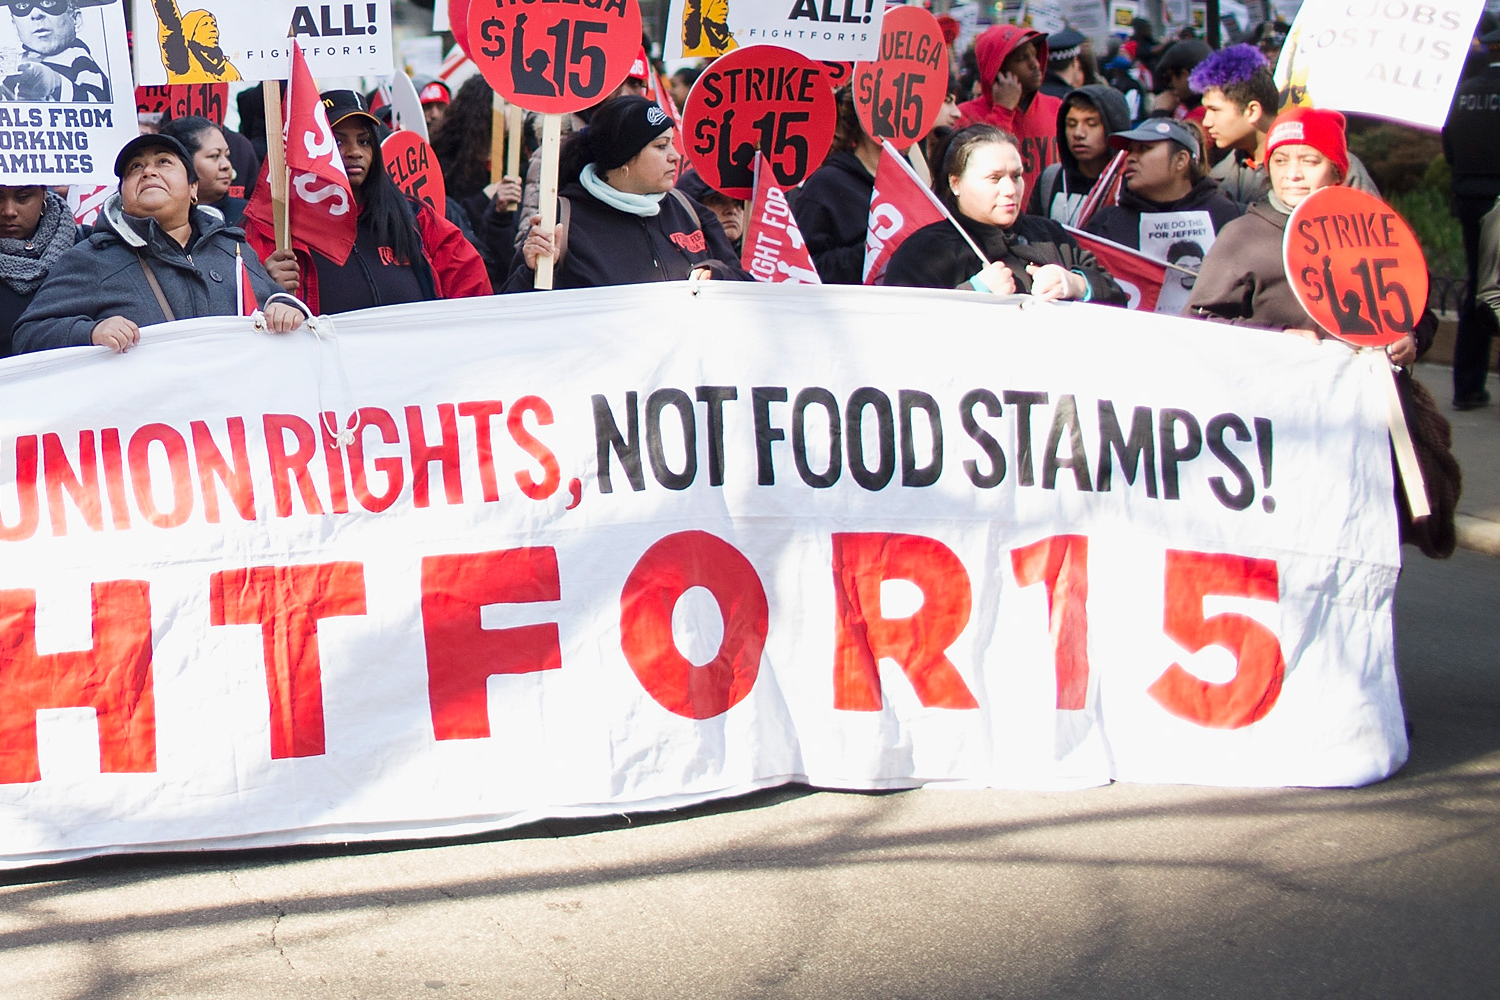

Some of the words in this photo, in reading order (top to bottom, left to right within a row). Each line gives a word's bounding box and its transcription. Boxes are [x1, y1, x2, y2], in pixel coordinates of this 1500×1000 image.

[287, 3, 378, 39] ALL!
[480, 16, 607, 98] $15
[1398, 34, 1452, 61] US
[703, 67, 819, 108] STRIKE
[1366, 62, 1444, 93] ALL!
[50, 108, 114, 128] FROM
[860, 71, 926, 139] $15
[1459, 93, 1500, 111] POLIC
[695, 110, 809, 186] $15
[1148, 231, 1168, 239] FOR
[1171, 228, 1206, 238] JEFFREY
[1154, 222, 1170, 230] WE
[1172, 220, 1186, 229] DO
[1188, 219, 1203, 228] THIS
[1299, 213, 1399, 254] STRIKE
[1301, 256, 1414, 333] $15
[263, 394, 583, 518] RIGHTS,
[591, 384, 738, 495] NOT
[752, 386, 942, 491] FOOD
[961, 388, 1277, 514] STAMPS!
